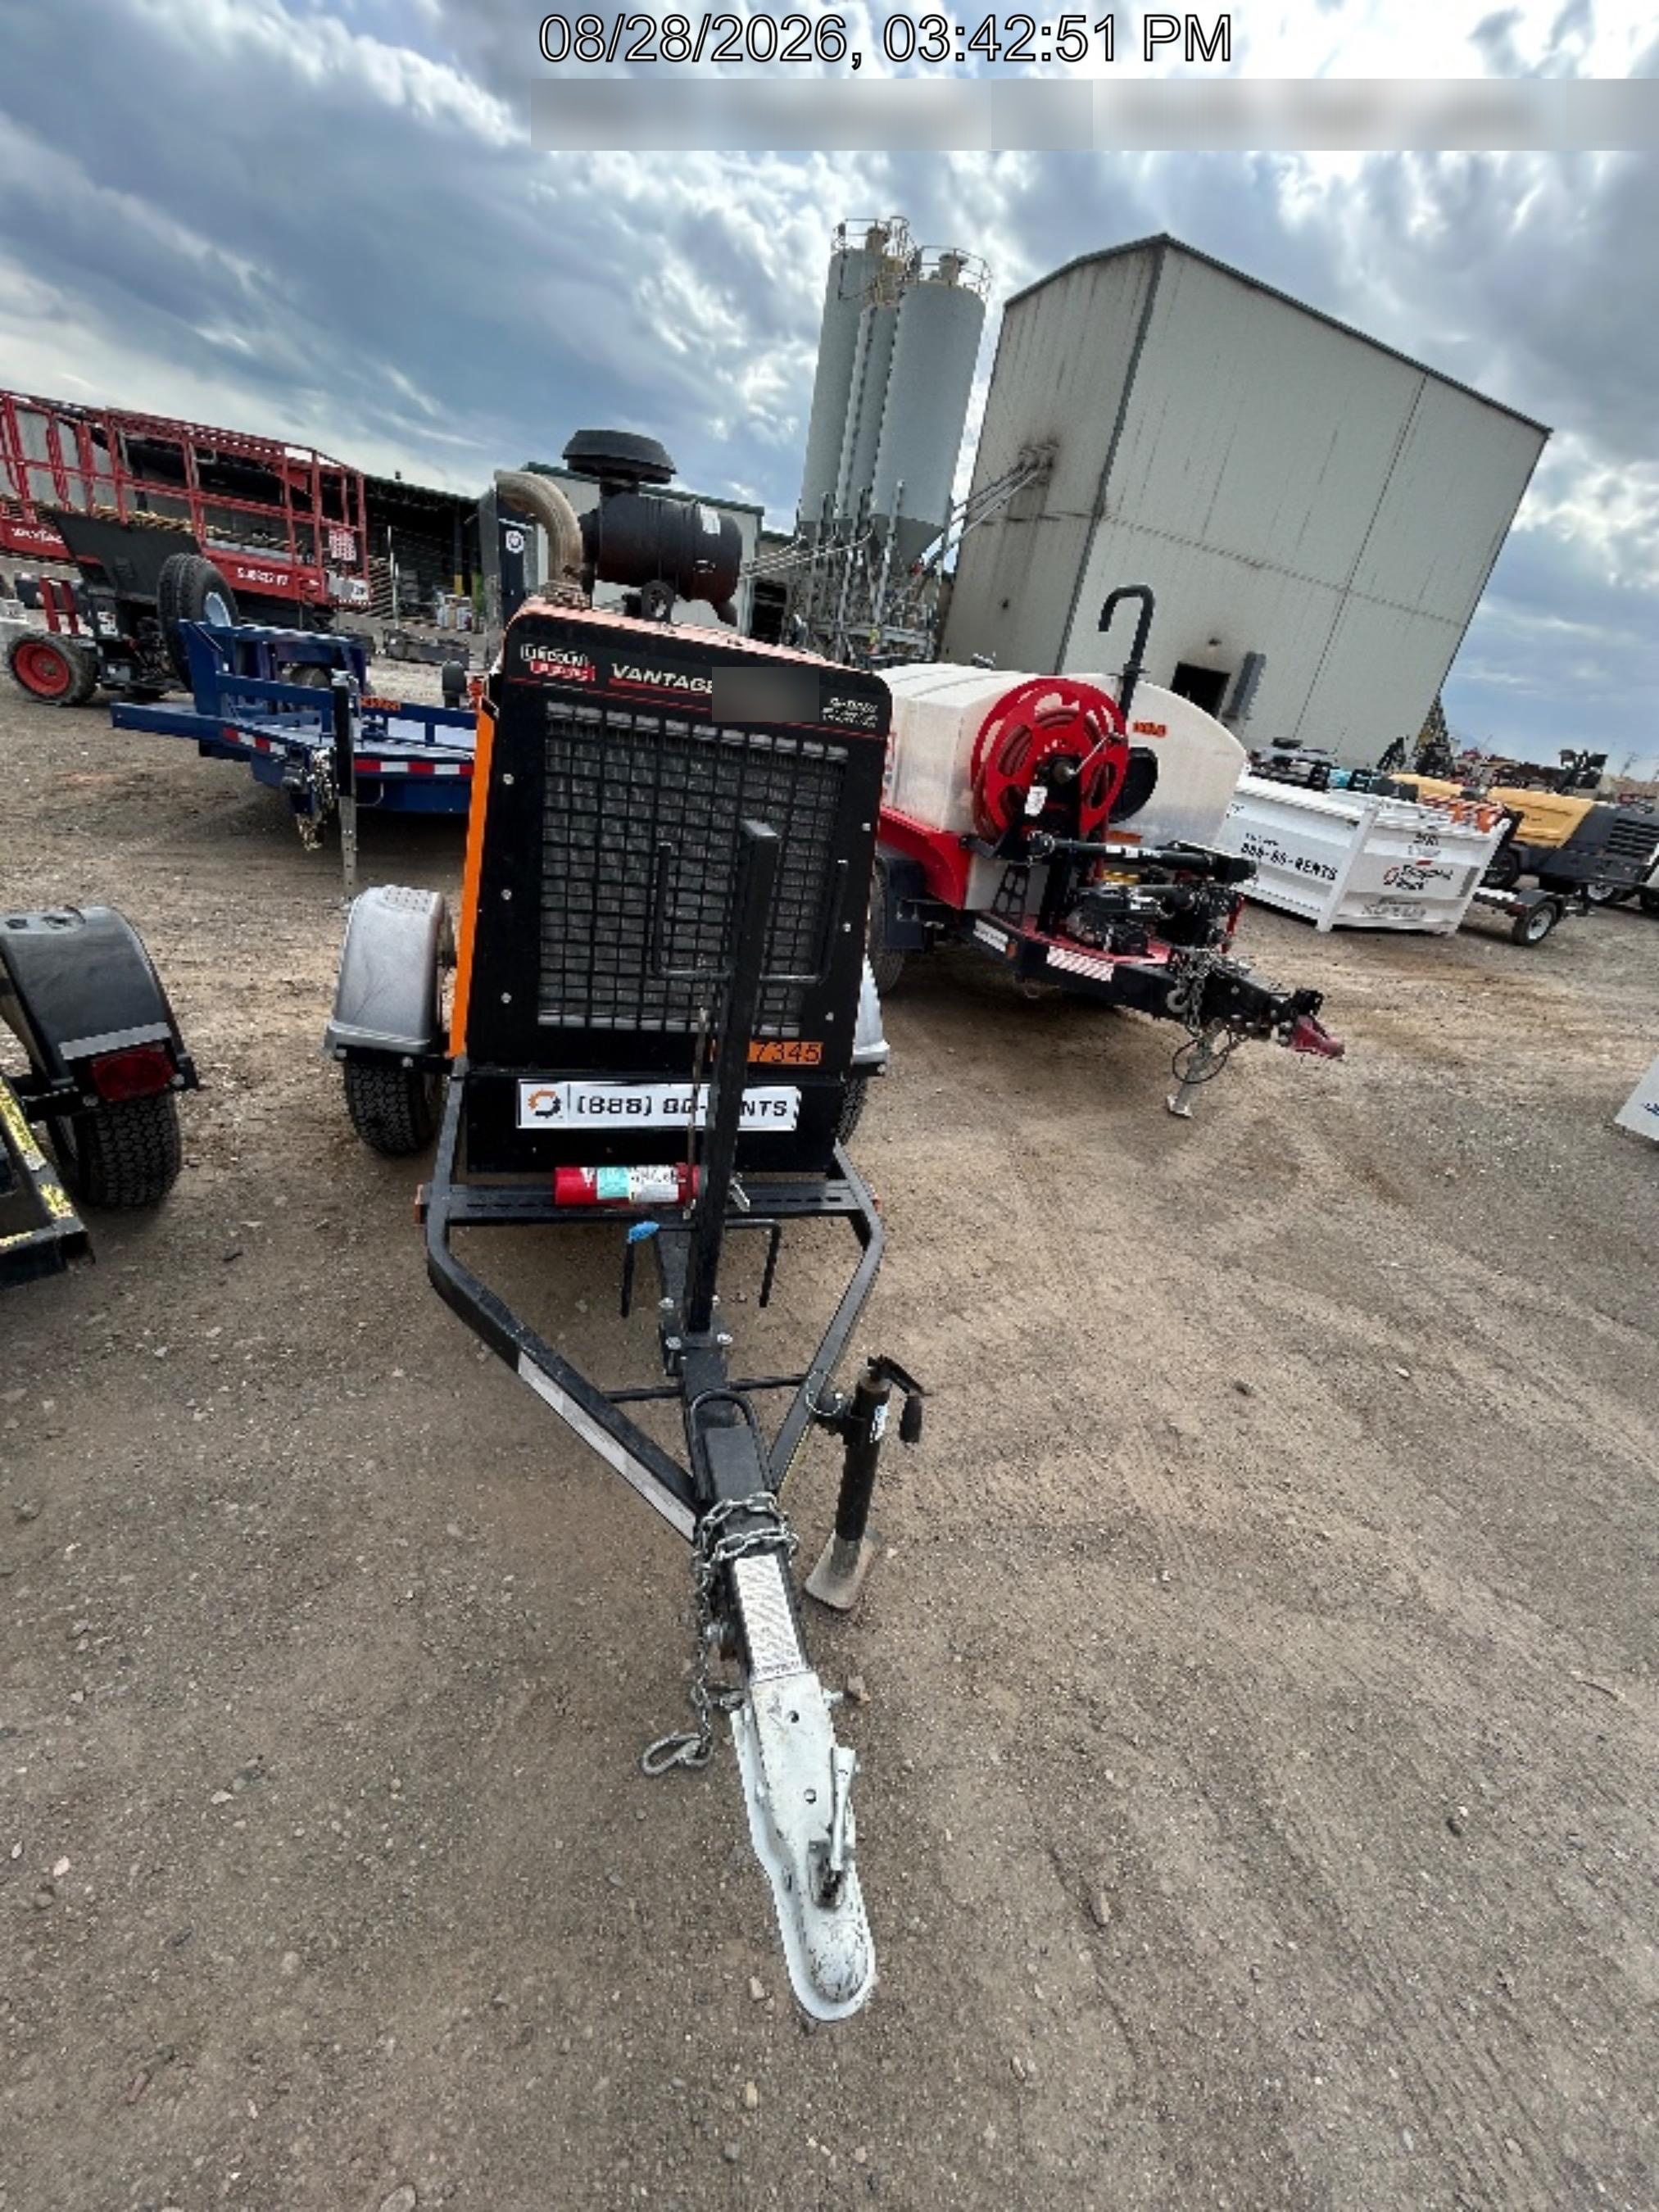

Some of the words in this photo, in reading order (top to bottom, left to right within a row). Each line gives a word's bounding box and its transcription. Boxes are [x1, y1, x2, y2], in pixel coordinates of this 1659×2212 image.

[754, 1041, 819, 1063] 7345
[577, 1095, 652, 1117] (888)
[663, 1098, 788, 1117] 80-NTS
